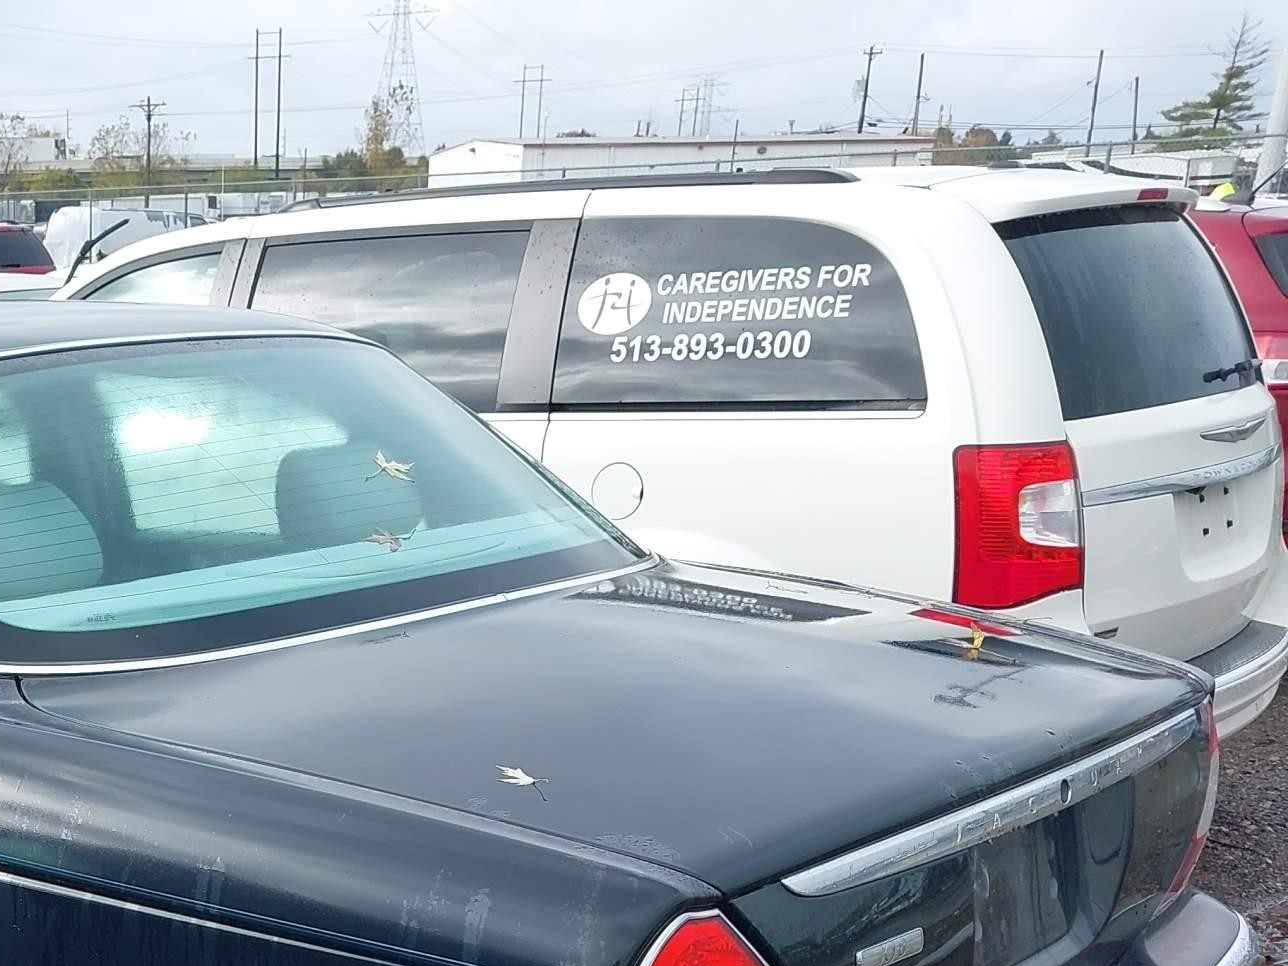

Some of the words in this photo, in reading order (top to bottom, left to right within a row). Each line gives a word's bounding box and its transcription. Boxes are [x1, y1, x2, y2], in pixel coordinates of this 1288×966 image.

[656, 266, 812, 297] CAREGIVERS
[816, 263, 872, 289] FOR
[662, 294, 853, 324] INDEPENDENCE
[610, 329, 812, 364] 513-893-0300
